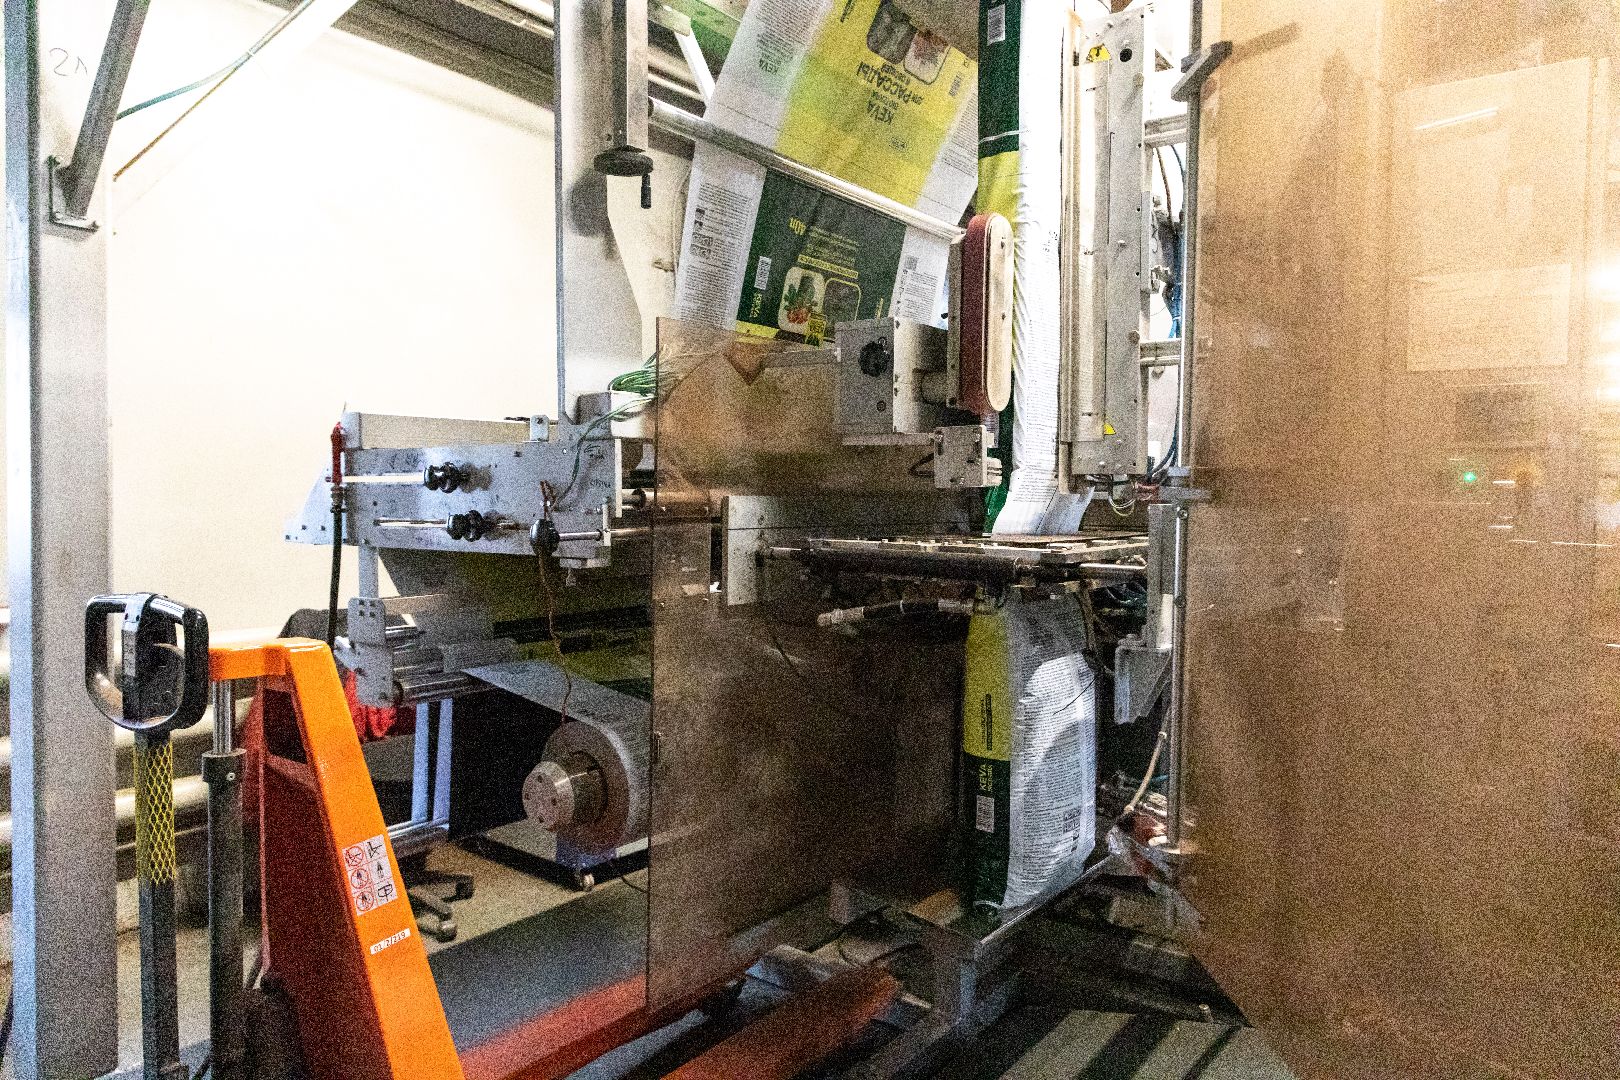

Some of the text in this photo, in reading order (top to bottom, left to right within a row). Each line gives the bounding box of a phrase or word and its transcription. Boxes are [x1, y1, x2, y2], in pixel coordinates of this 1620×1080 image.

[856, 61, 912, 104] РАССАДЫ
[867, 101, 895, 125] KEVA
[979, 763, 987, 790] KEVA
